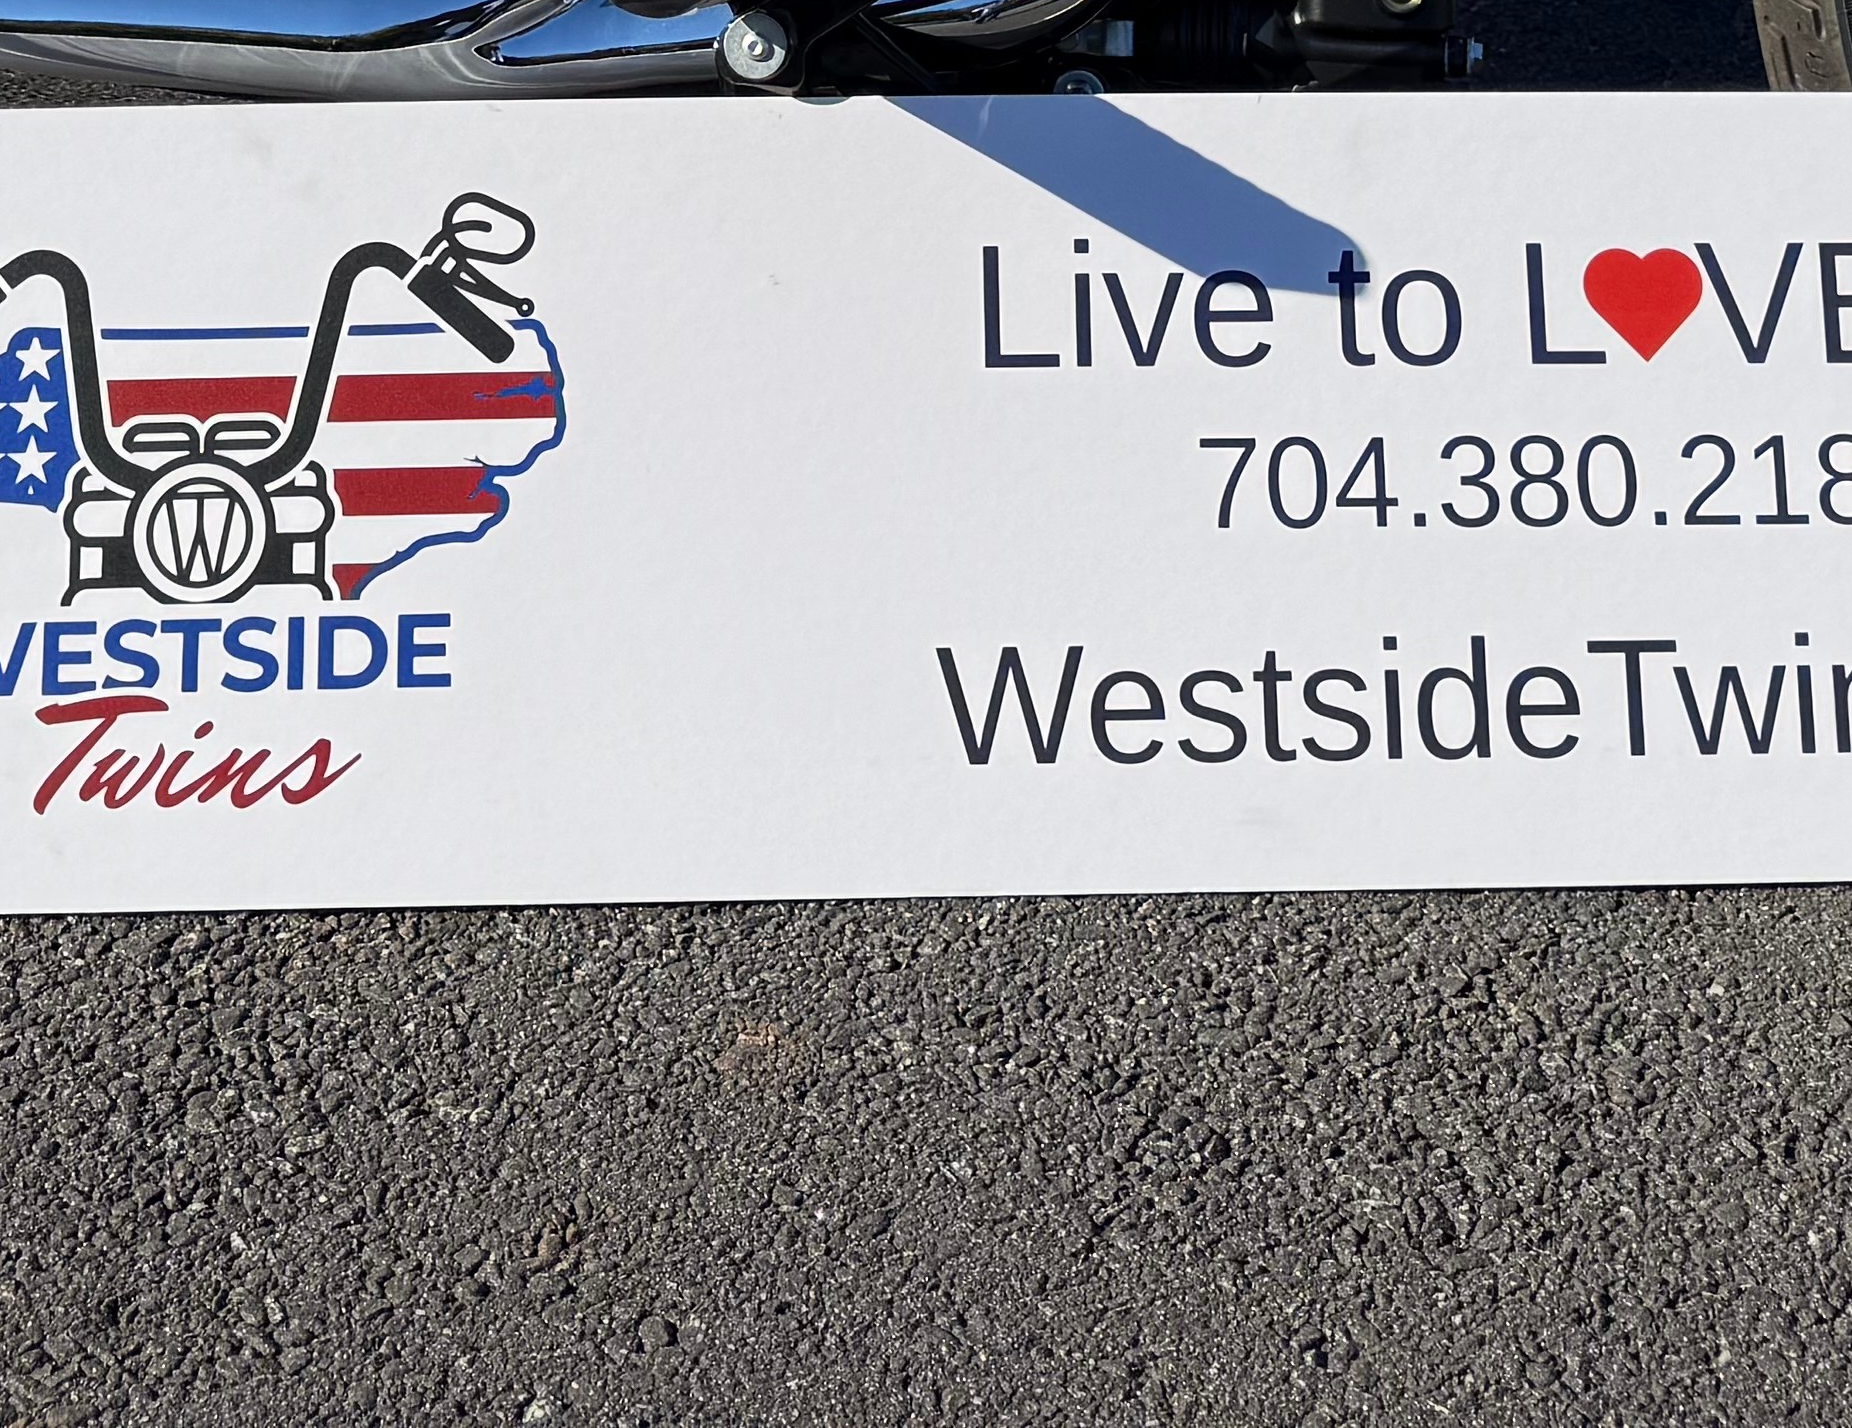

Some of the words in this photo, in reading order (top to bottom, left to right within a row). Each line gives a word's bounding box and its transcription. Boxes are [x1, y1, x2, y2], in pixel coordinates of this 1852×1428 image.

[982, 238, 1275, 369] Live
[1327, 249, 1462, 367] to
[33, 696, 361, 815] Twins
